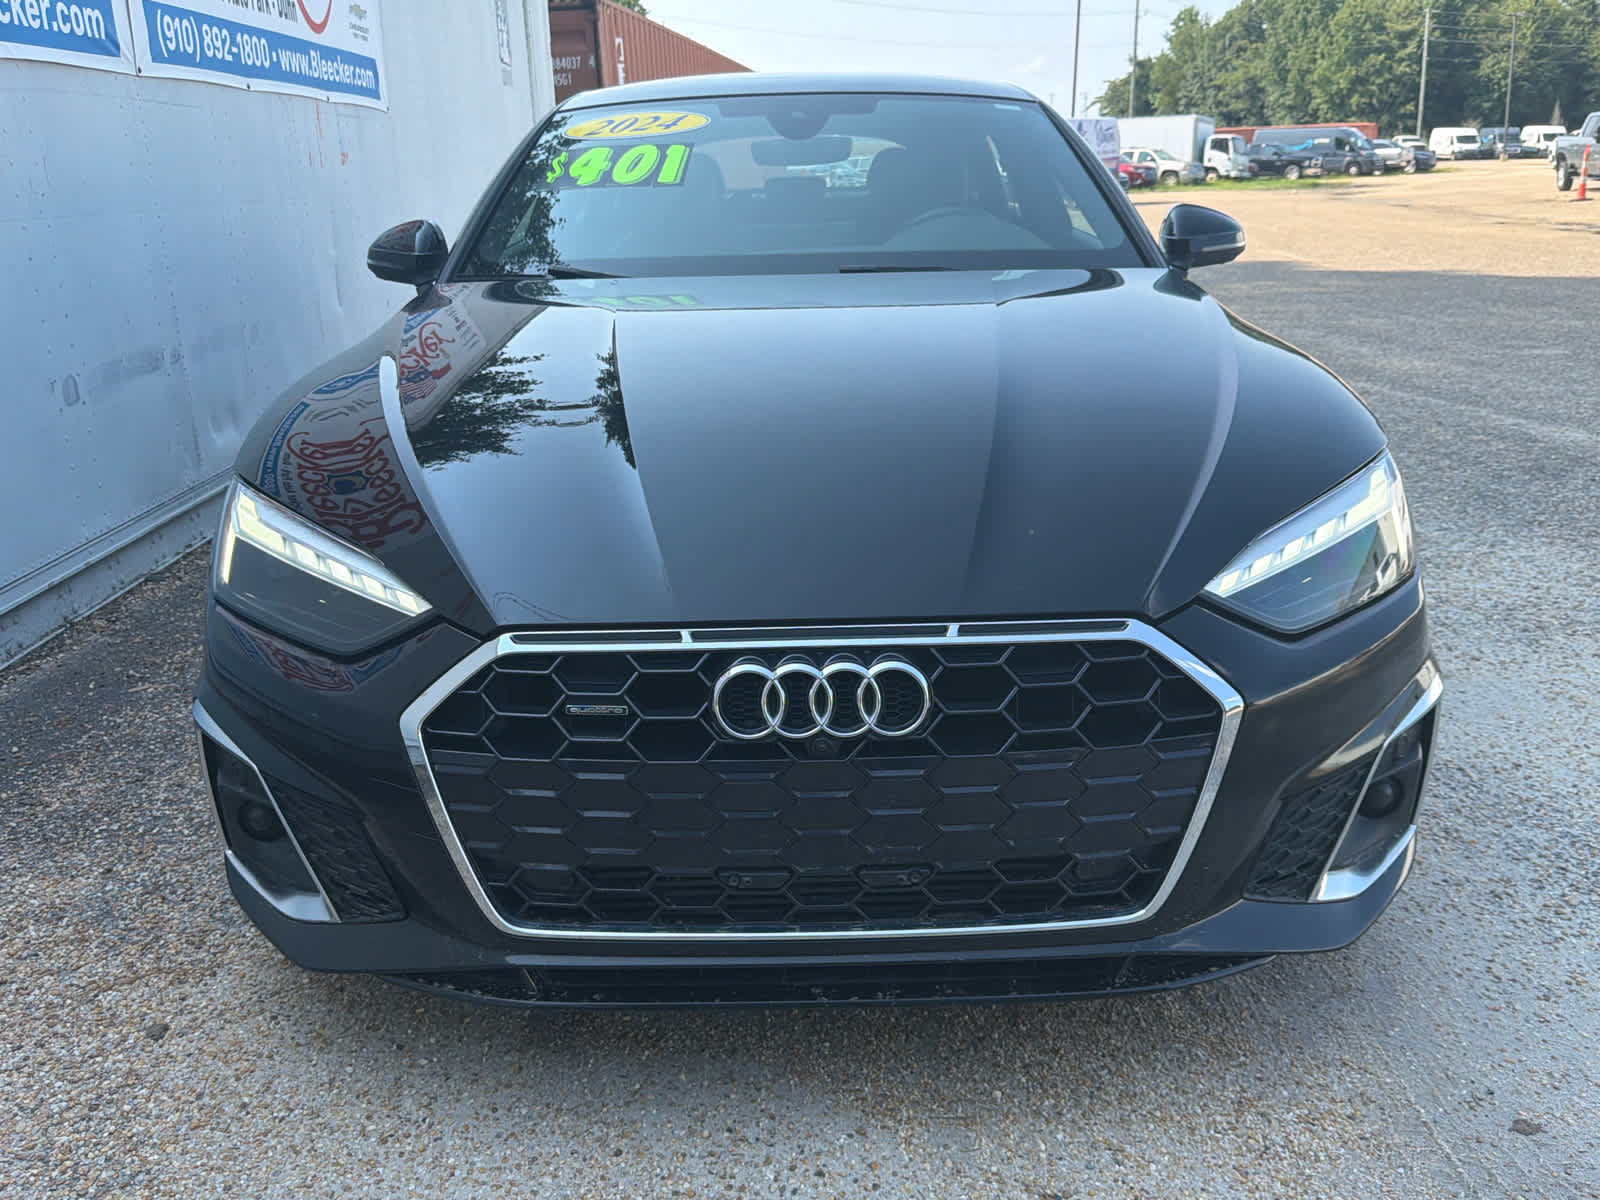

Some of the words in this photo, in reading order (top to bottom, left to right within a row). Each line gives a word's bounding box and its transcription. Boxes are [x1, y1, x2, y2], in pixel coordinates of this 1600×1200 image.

[157, 8, 200, 63] (910)
[202, 23, 271, 69] 892-1800
[278, 48, 376, 89] www.Bleecker.com
[584, 114, 689, 137] 2024
[546, 144, 690, 186] $401
